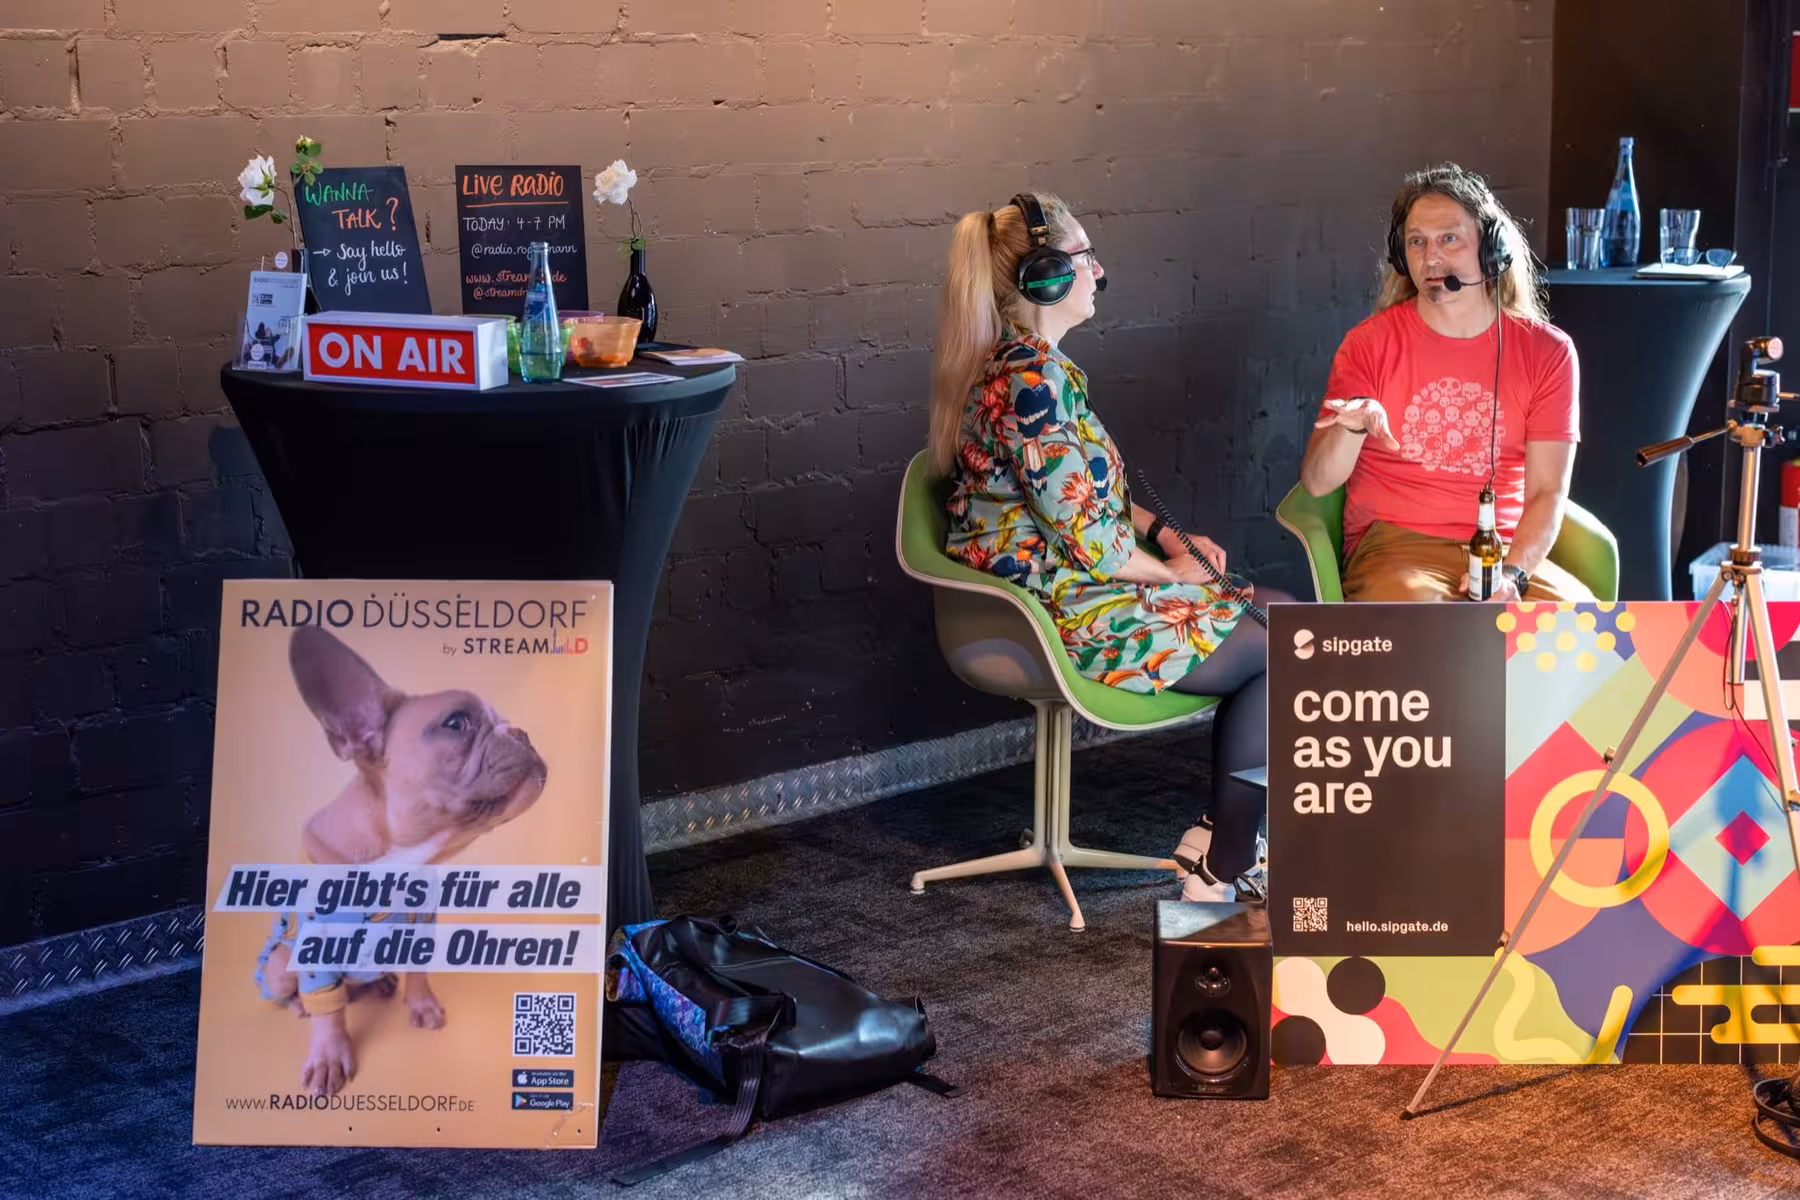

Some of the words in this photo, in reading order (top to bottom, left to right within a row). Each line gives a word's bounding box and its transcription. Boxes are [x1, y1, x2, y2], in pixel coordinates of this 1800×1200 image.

[305, 182, 374, 206] WANNA
[548, 214, 566, 230] PM
[337, 243, 367, 271] Say
[371, 240, 406, 258] hello
[328, 268, 338, 287] &
[344, 268, 376, 296] join
[319, 332, 382, 369] ON
[397, 337, 466, 374] AIR
[241, 599, 354, 629] RADIO
[363, 592, 587, 629] DÜSSELDORF
[443, 643, 457, 656] by
[1322, 637, 1393, 656] sipgate
[1294, 690, 1430, 722] come
[1293, 736, 1352, 768] as
[1363, 736, 1452, 777] you
[1293, 782, 1372, 814] are
[226, 871, 308, 907] Hier
[439, 871, 500, 908] für
[507, 872, 581, 908] alle
[1346, 920, 1449, 934] hello.sipgate.de
[297, 929, 368, 964] auf
[374, 929, 435, 965] die
[446, 929, 580, 966] Ohren!
[530, 1076, 548, 1086] App
[548, 1076, 569, 1086] Store
[529, 1098, 554, 1109] Google
[555, 1099, 570, 1109] Play
